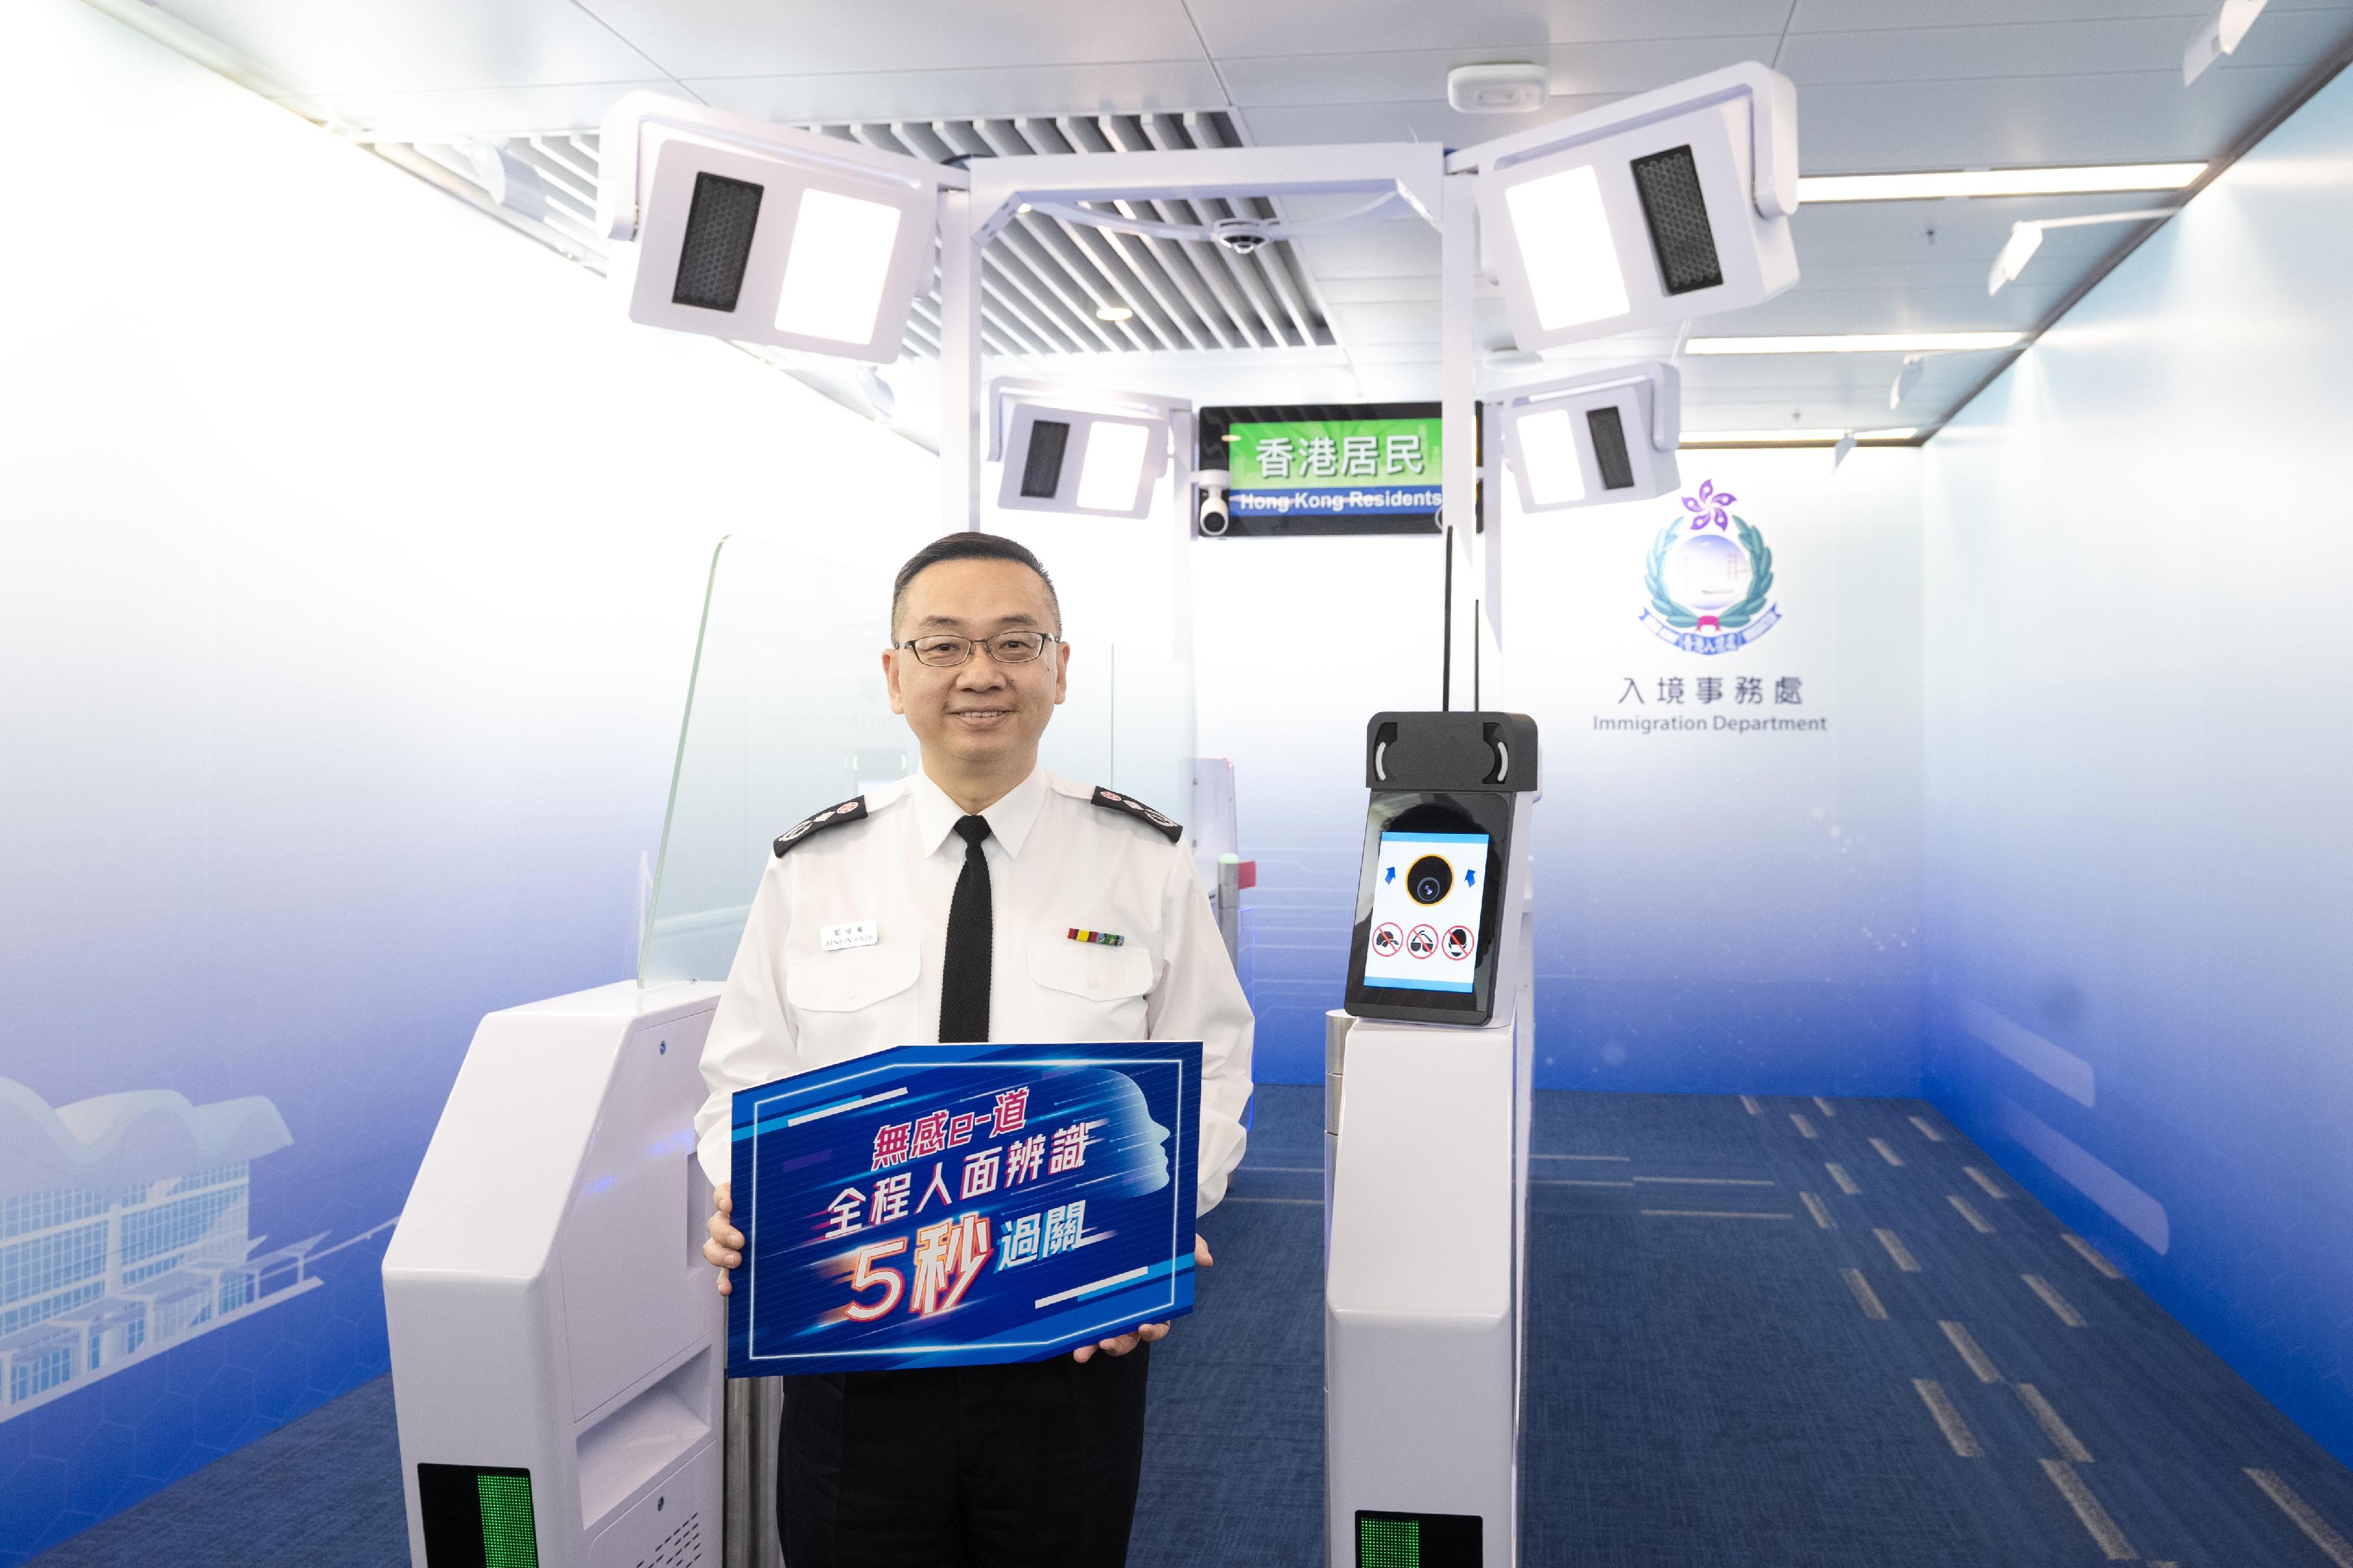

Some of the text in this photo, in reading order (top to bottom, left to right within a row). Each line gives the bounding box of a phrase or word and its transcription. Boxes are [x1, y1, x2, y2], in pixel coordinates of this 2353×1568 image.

[1255, 435, 1424, 478] 香港居民
[1241, 490, 1442, 513] Hong Kong Residents
[1618, 676, 1802, 705] 入境事務處
[1594, 716, 1828, 735] Immigration Department
[871, 1086, 1029, 1172] 無感e-道
[825, 1122, 1089, 1239] 全程人面辨識
